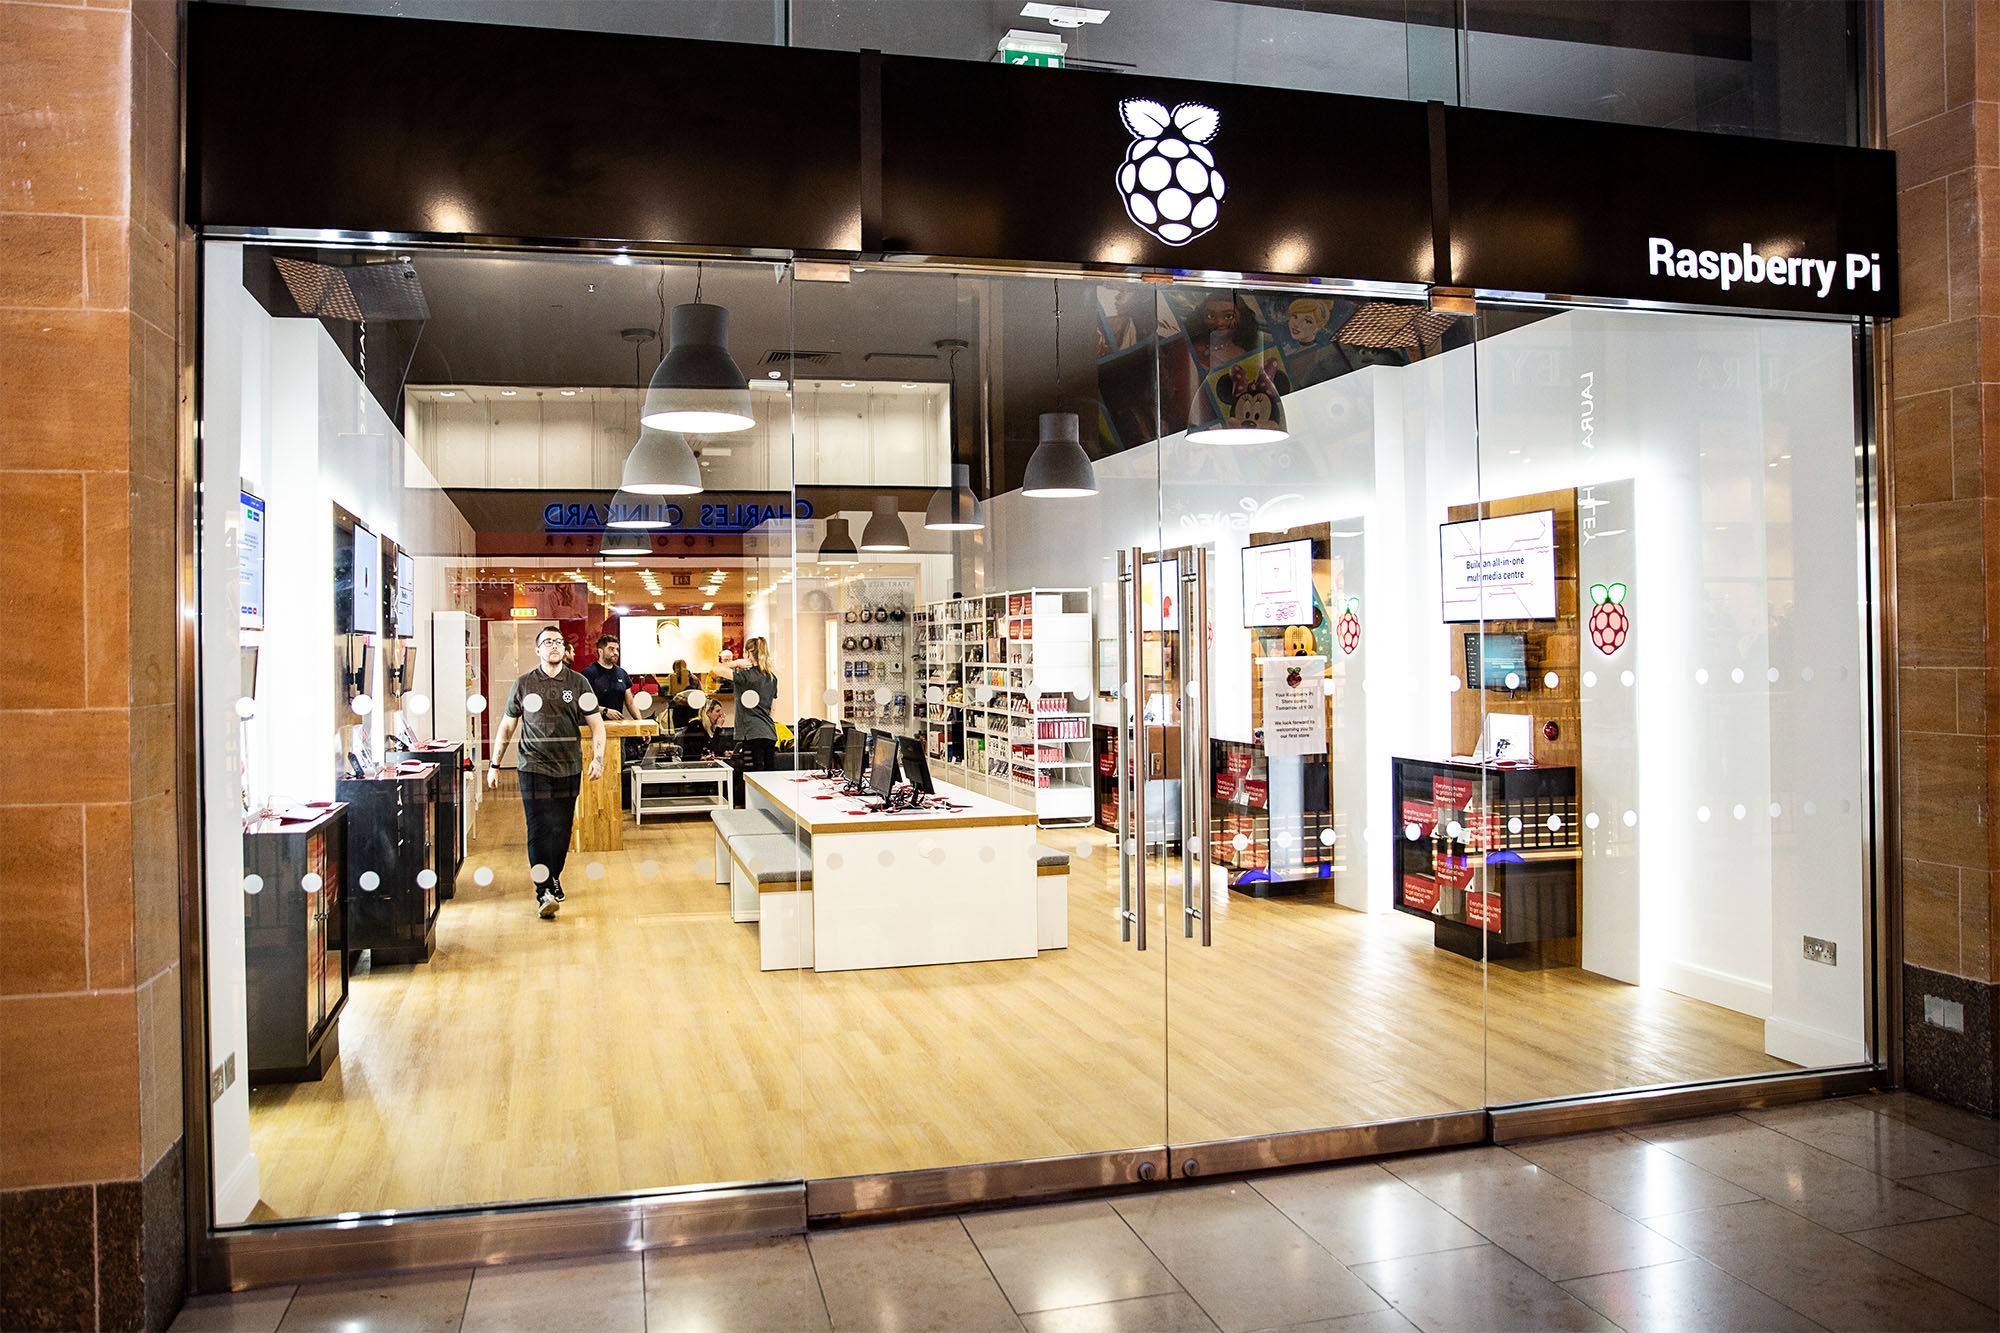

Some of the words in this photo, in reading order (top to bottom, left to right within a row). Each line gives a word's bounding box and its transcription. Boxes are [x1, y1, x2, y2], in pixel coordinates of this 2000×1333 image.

[1648, 237, 1837, 298] Raspberry
[1846, 253, 1881, 292] Pi
[1503, 571, 1524, 580] centre
